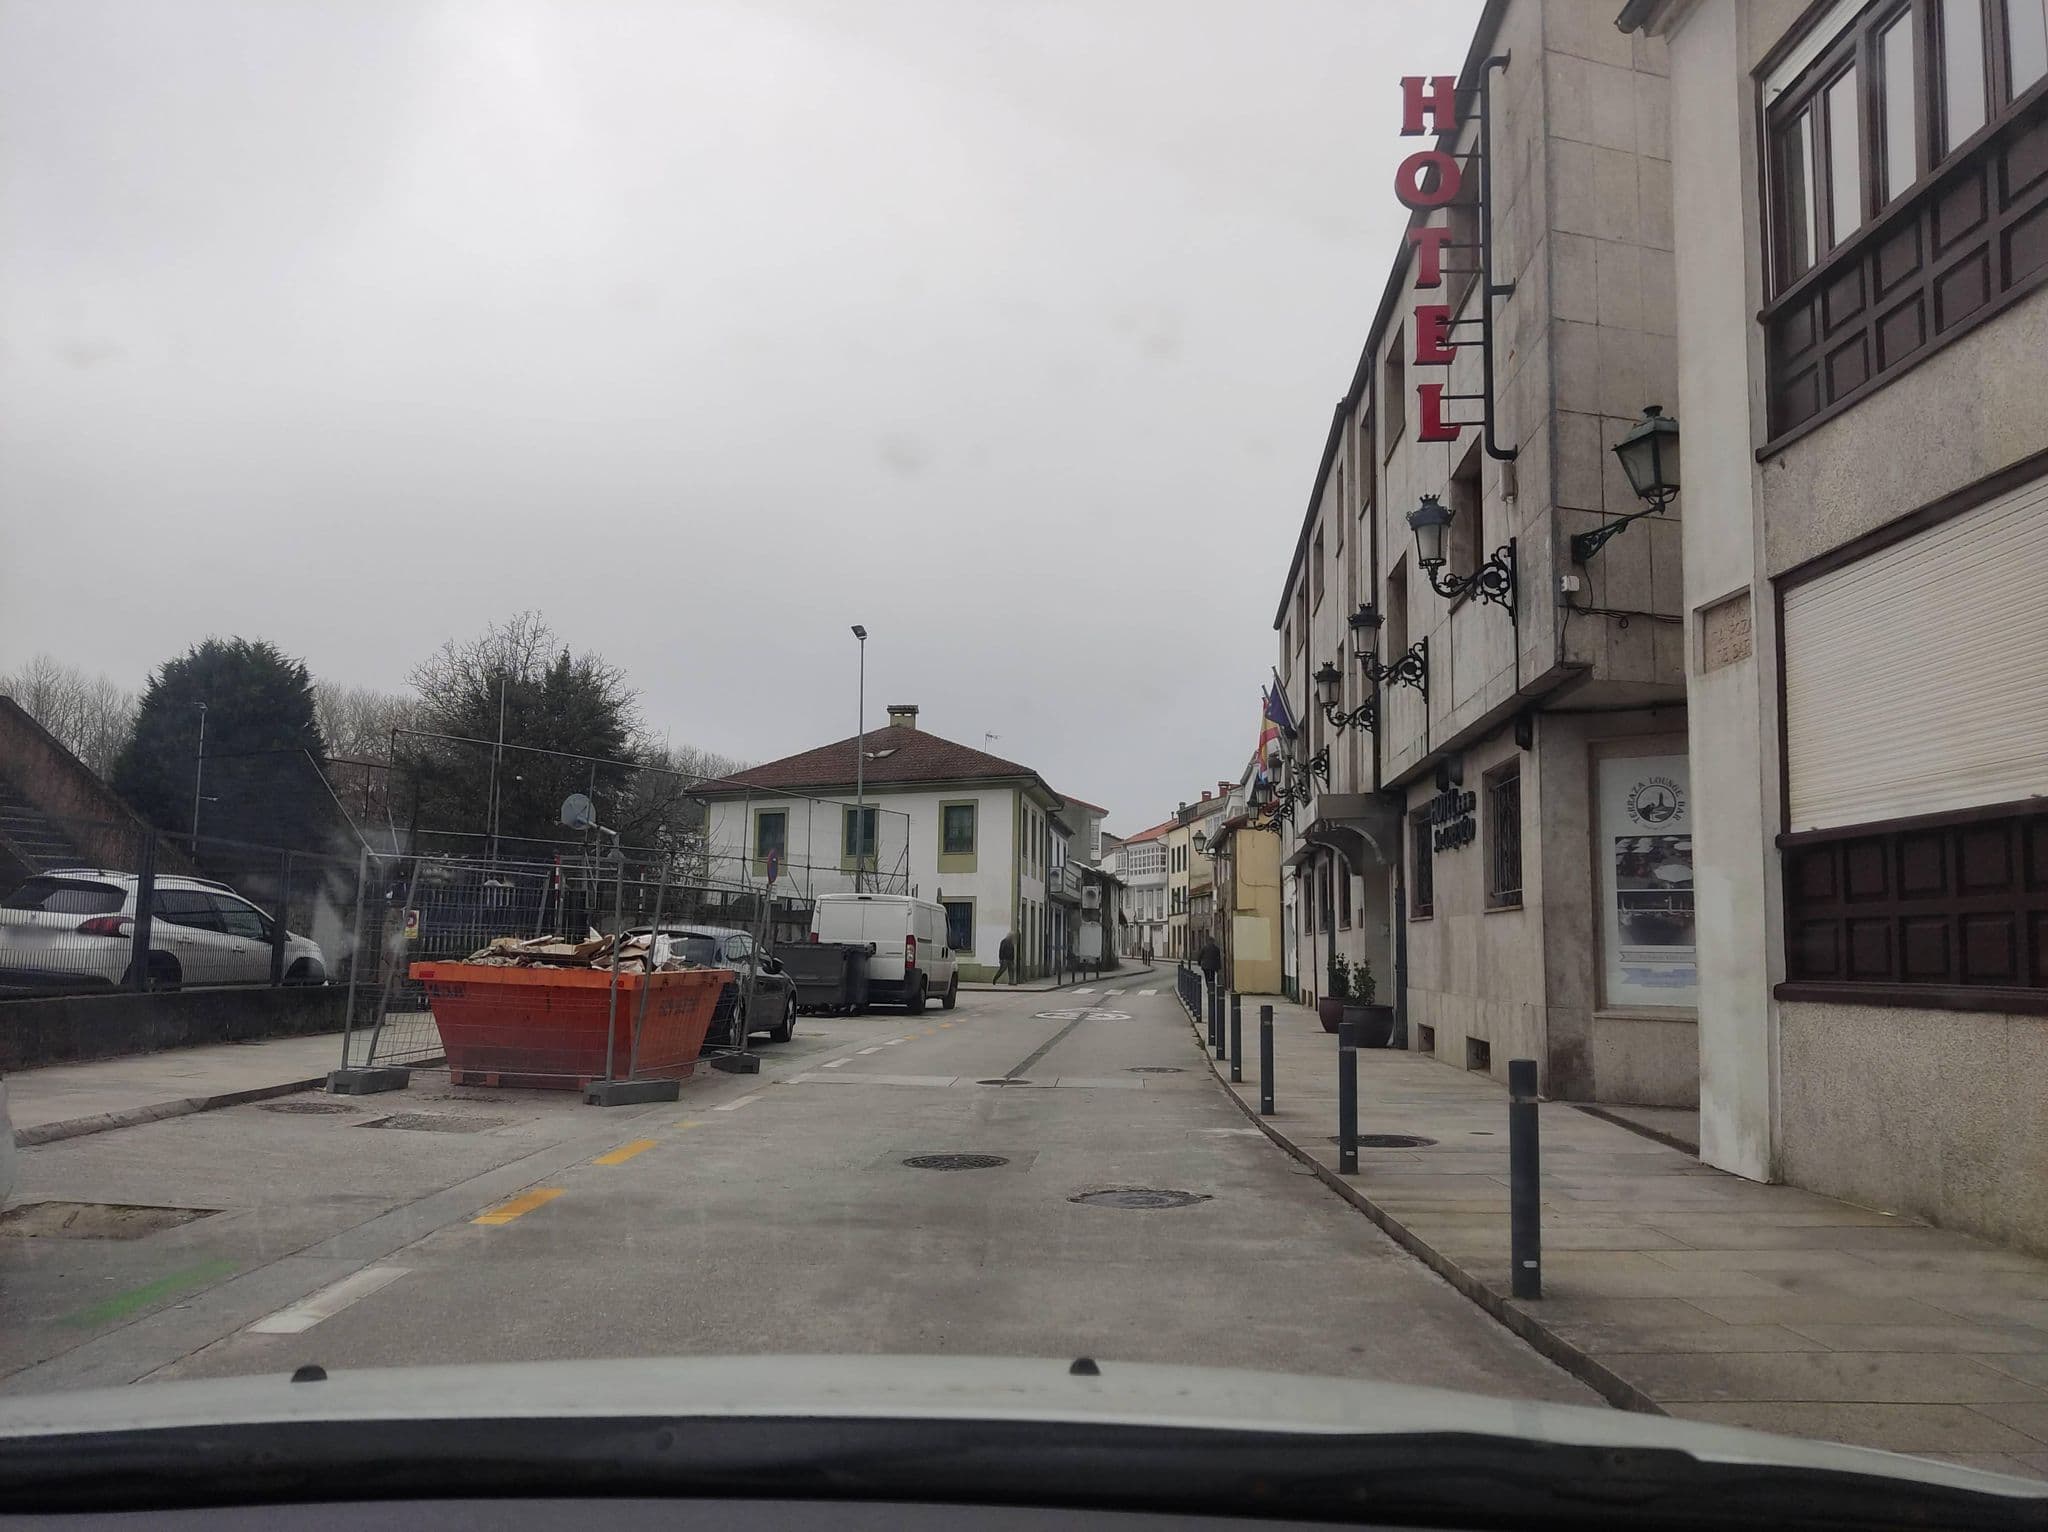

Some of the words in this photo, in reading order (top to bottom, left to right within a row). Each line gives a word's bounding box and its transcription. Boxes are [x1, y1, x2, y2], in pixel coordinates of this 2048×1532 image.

[1394, 75, 1462, 443] HOTEL
[1627, 782, 1646, 824] TERRAZA
[1649, 776, 1684, 797] LOUNGE
[1672, 801, 1686, 821] BAR
